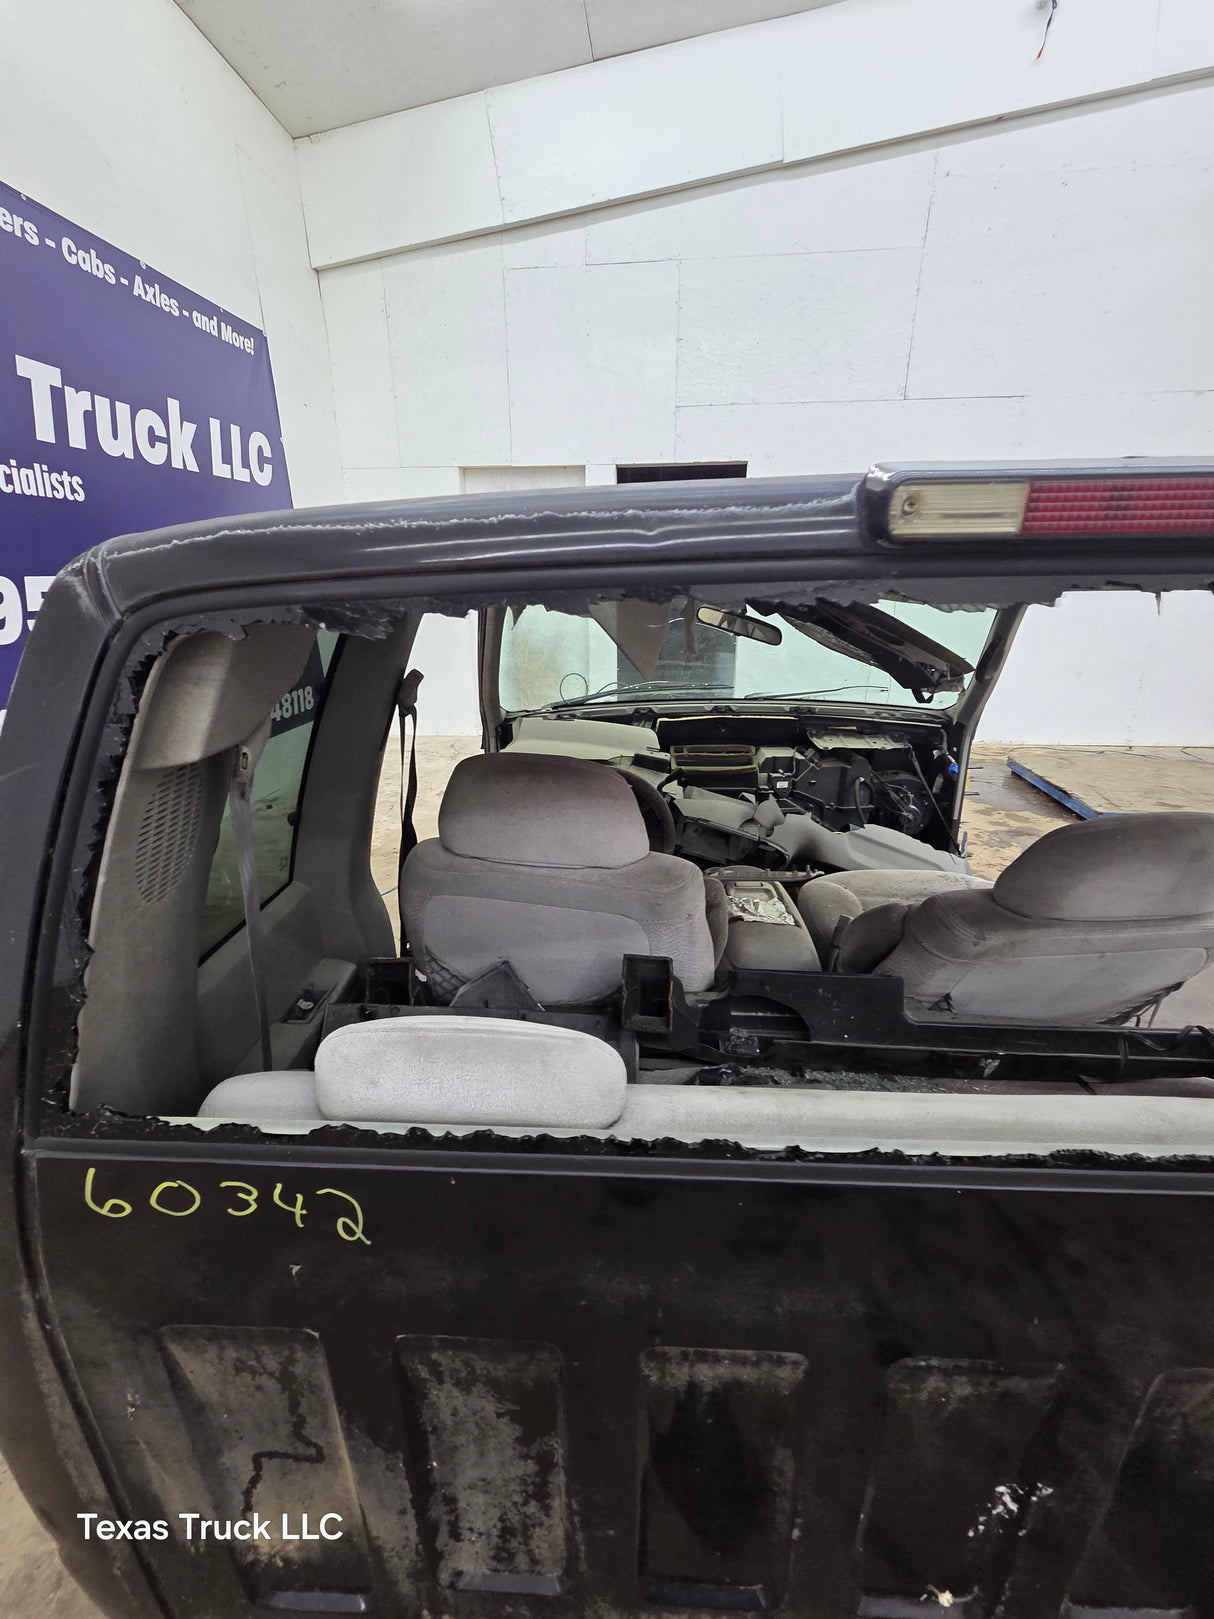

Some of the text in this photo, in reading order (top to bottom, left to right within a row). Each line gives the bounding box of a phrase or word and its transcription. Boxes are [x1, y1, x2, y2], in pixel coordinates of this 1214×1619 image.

[61, 236, 117, 285] Cabs
[133, 274, 180, 317] Axles
[192, 309, 218, 338] and
[220, 321, 255, 356] More!
[14, 354, 273, 487] Truck LLC
[0, 458, 86, 502] cialists
[84, 1167, 372, 1246] 60342
